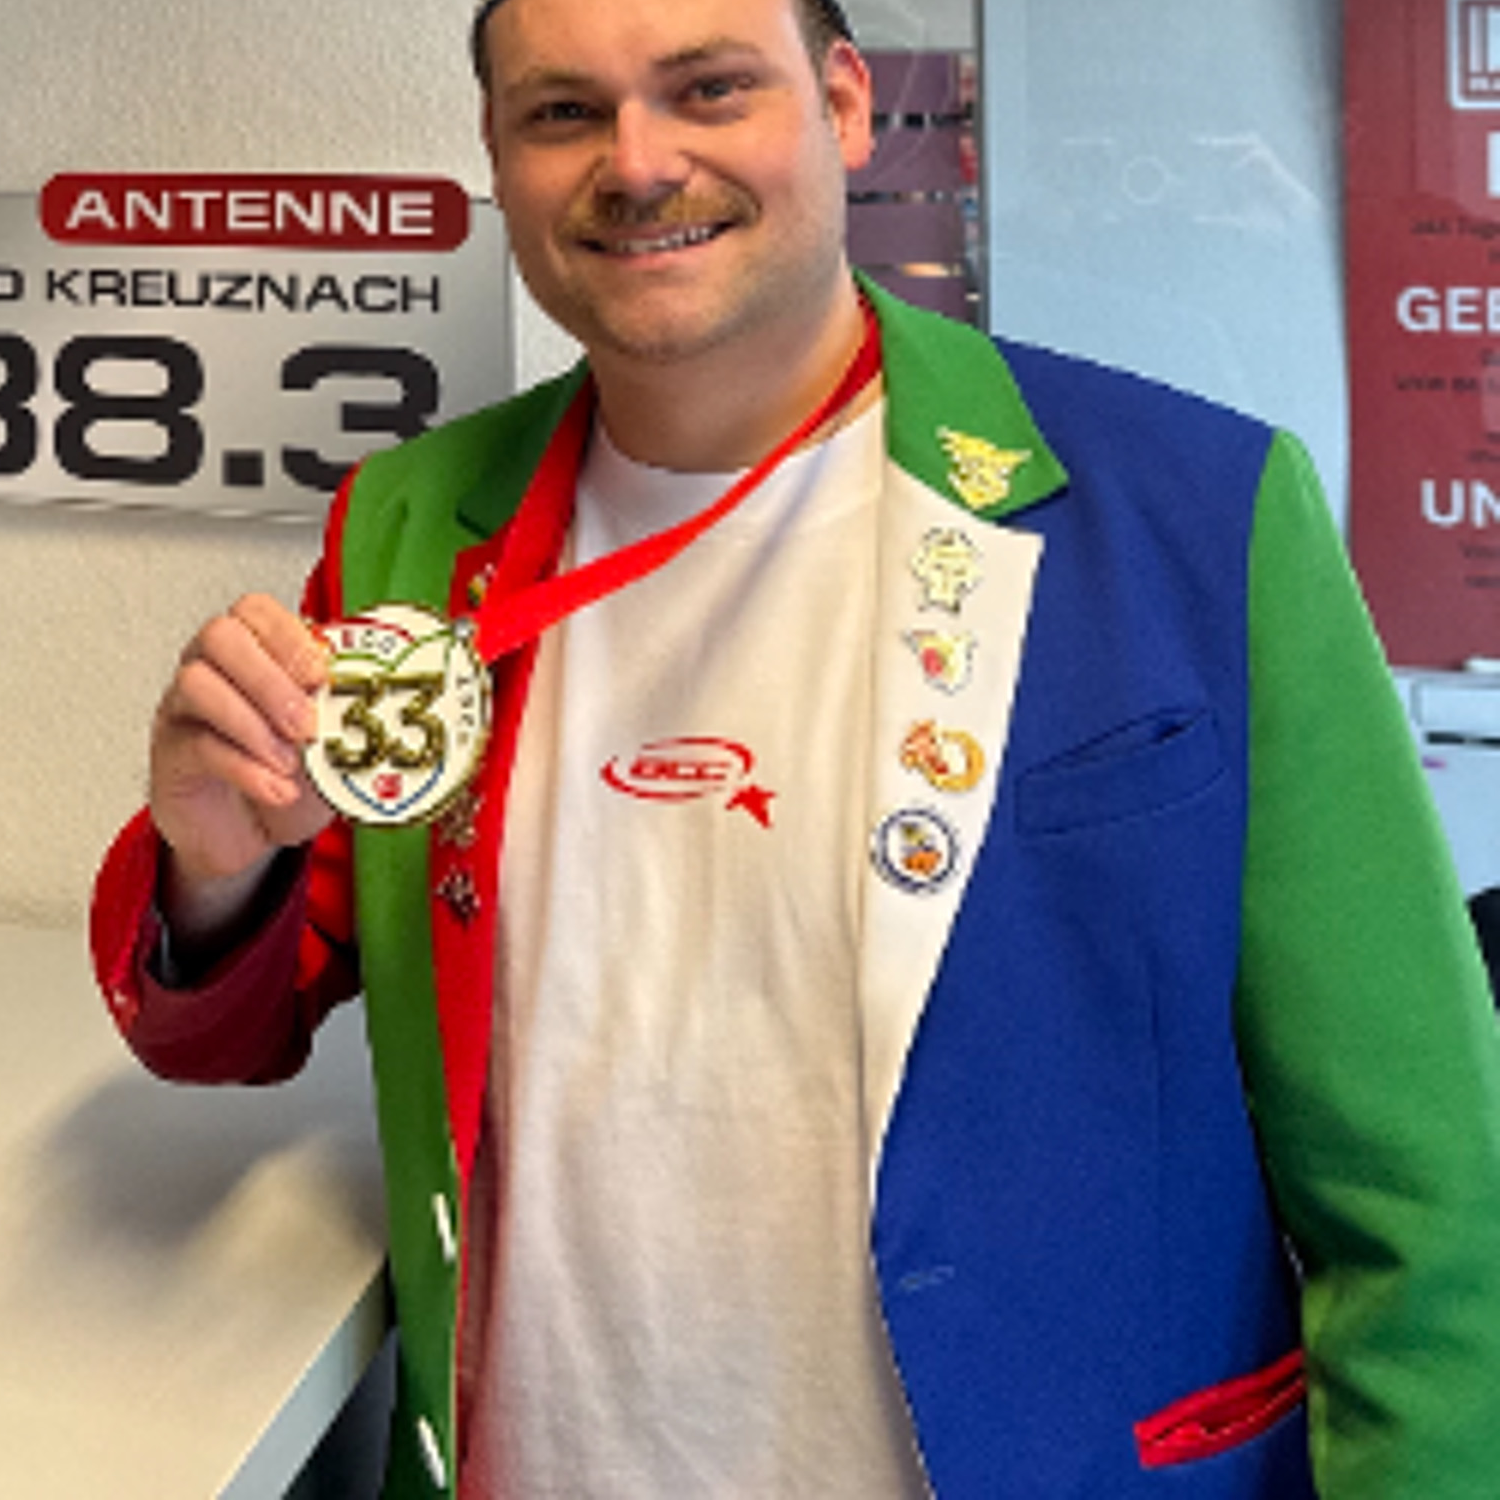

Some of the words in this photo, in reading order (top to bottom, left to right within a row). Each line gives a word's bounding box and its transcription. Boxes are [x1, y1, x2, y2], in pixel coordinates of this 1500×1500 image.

[65, 190, 436, 237] ANTENNE
[46, 269, 441, 314] KREUZNACH
[324, 672, 444, 769] 33
